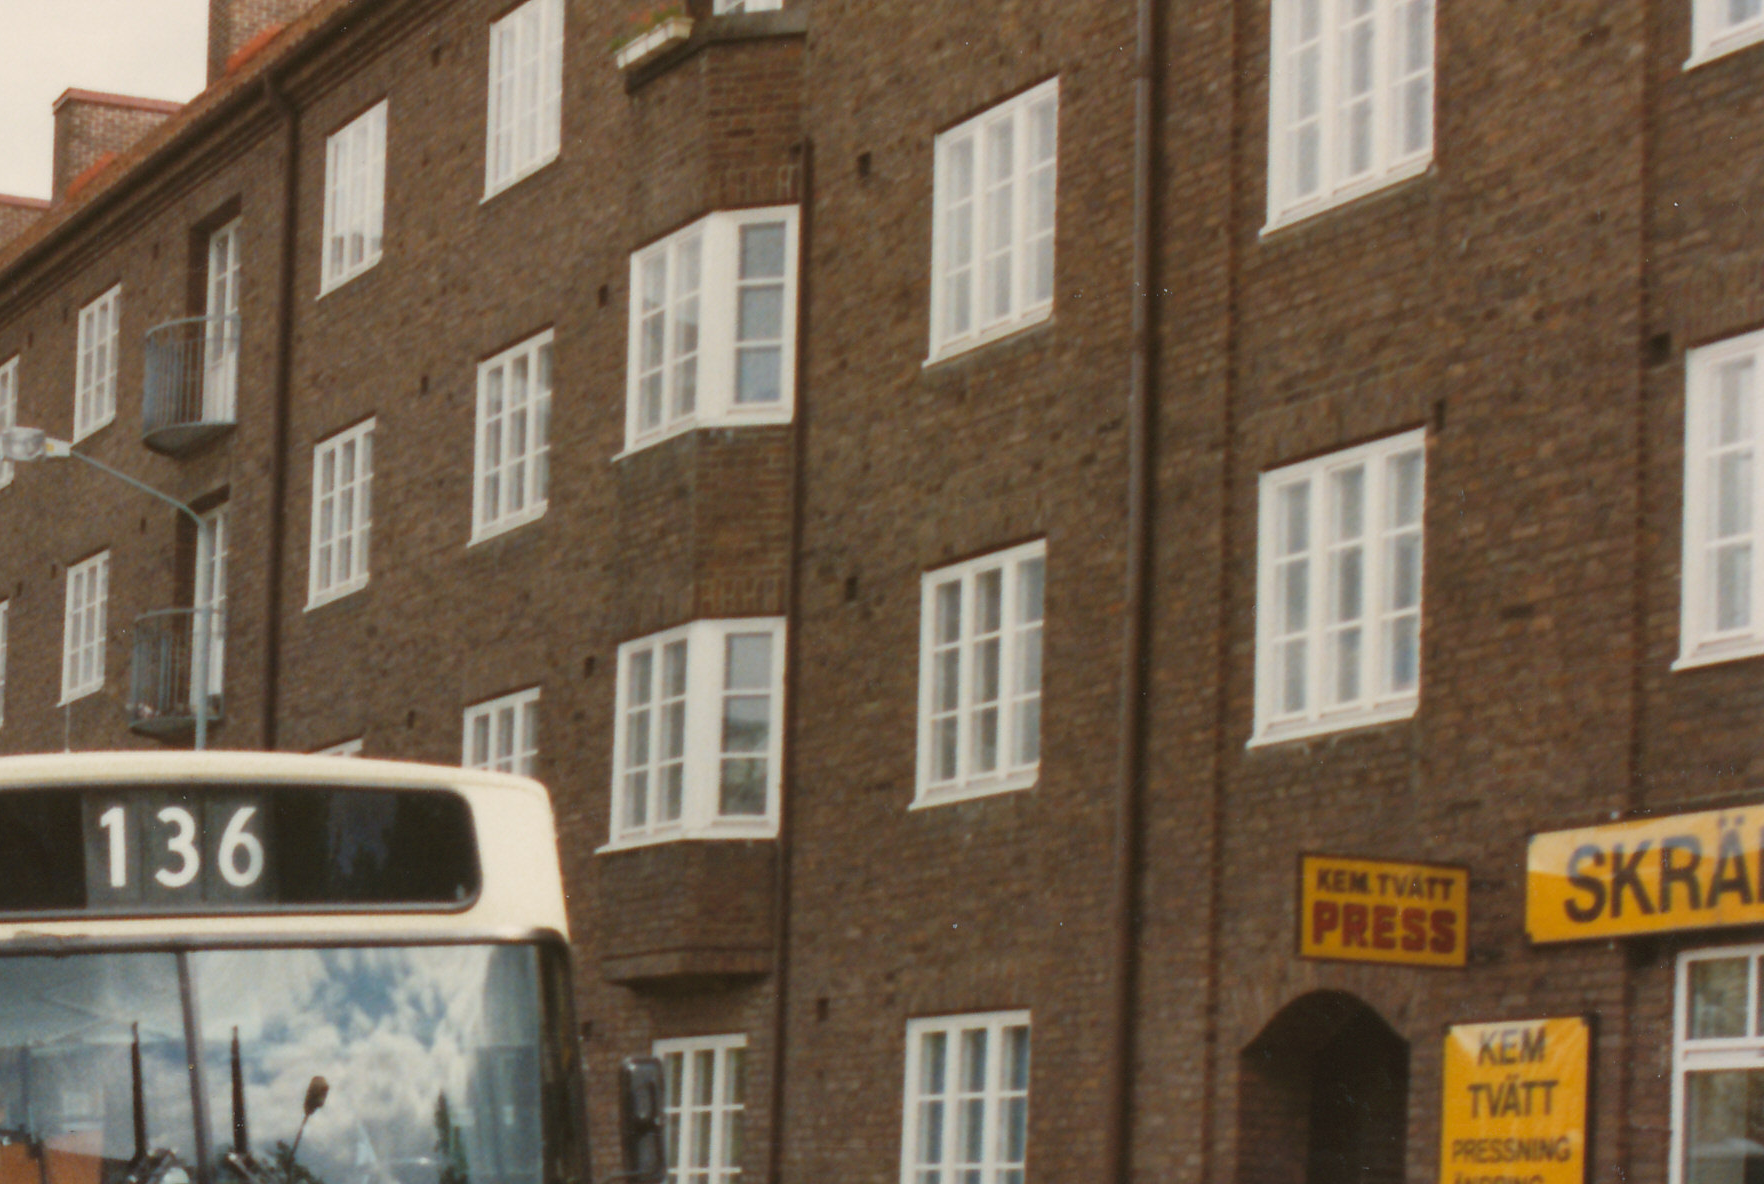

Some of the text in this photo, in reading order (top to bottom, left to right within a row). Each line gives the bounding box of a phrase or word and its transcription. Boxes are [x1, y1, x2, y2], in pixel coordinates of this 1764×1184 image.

[100, 806, 264, 888] 136
[1564, 814, 1764, 924] SKRÄ
[1312, 901, 1457, 955] PRESS
[1477, 1027, 1547, 1066] KEM
[1467, 1074, 1559, 1119] TVÄTT
[1451, 1136, 1572, 1164] PRESSNING
